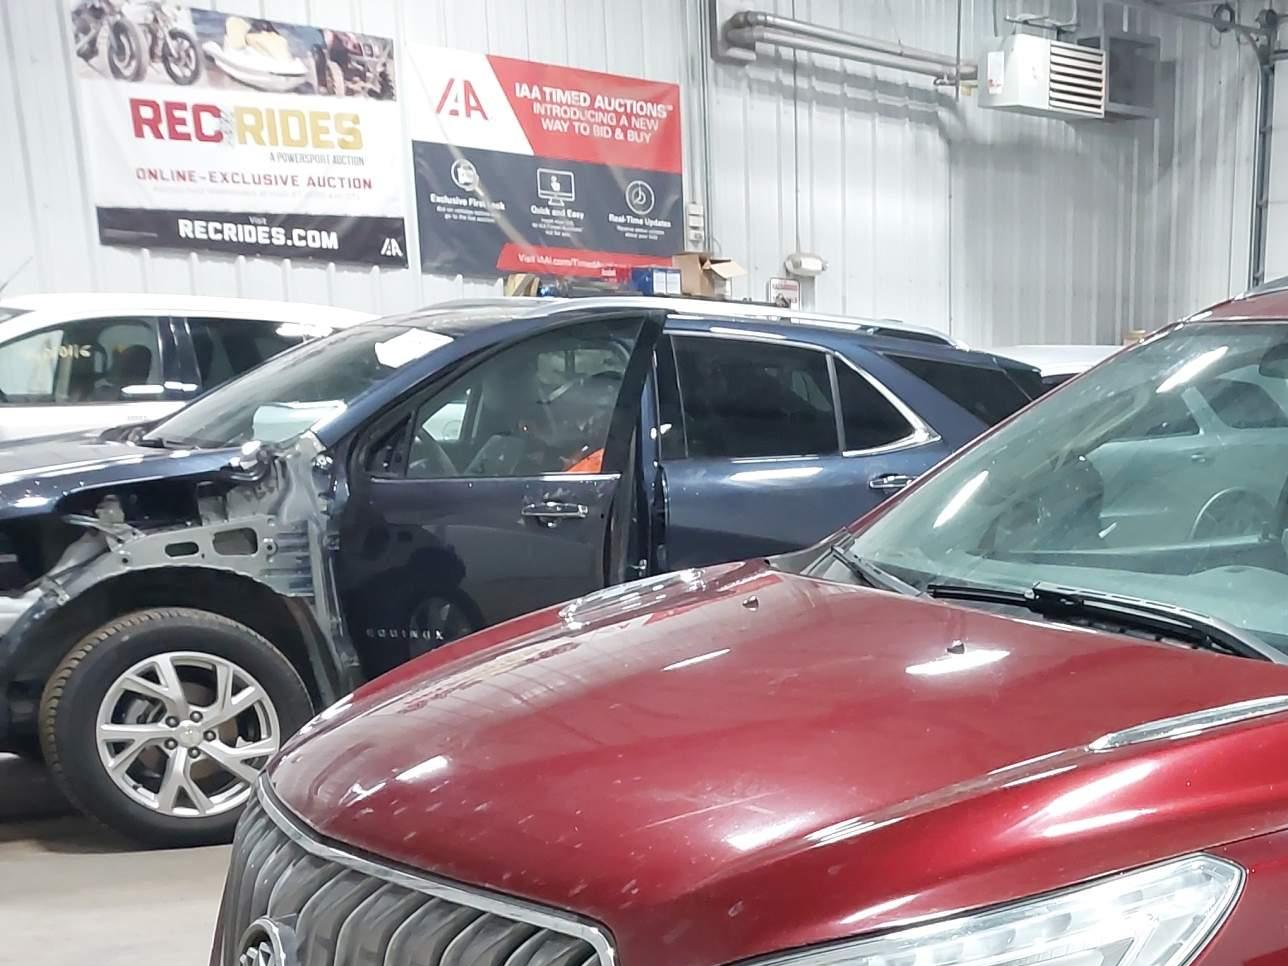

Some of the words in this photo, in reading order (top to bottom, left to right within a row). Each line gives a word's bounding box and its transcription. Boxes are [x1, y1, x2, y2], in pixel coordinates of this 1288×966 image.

[515, 83, 541, 100] IAA
[543, 86, 591, 107] TIMED
[129, 98, 224, 143] REC
[234, 105, 364, 150] RIDES
[533, 102, 617, 126] INTRODUCING
[619, 115, 629, 127] A
[631, 117, 659, 132] NEW
[541, 118, 569, 133] WAY
[573, 122, 590, 136] TO
[593, 125, 612, 138] BID
[614, 128, 624, 141] &
[627, 129, 652, 144] BUY
[269, 152, 276, 162] A
[332, 154, 365, 167] AUCTION
[136, 168, 300, 188] ONLINE-EXCLUSIVE
[307, 176, 373, 190] AUCTION
[249, 215, 267, 225] Visit
[530, 205, 550, 216] Quick
[551, 209, 566, 217] and
[566, 209, 584, 220] Easy
[644, 217, 672, 228] Updates
[178, 218, 339, 250] RECRIDES.COM
[366, 628, 444, 640] EQUINOX
